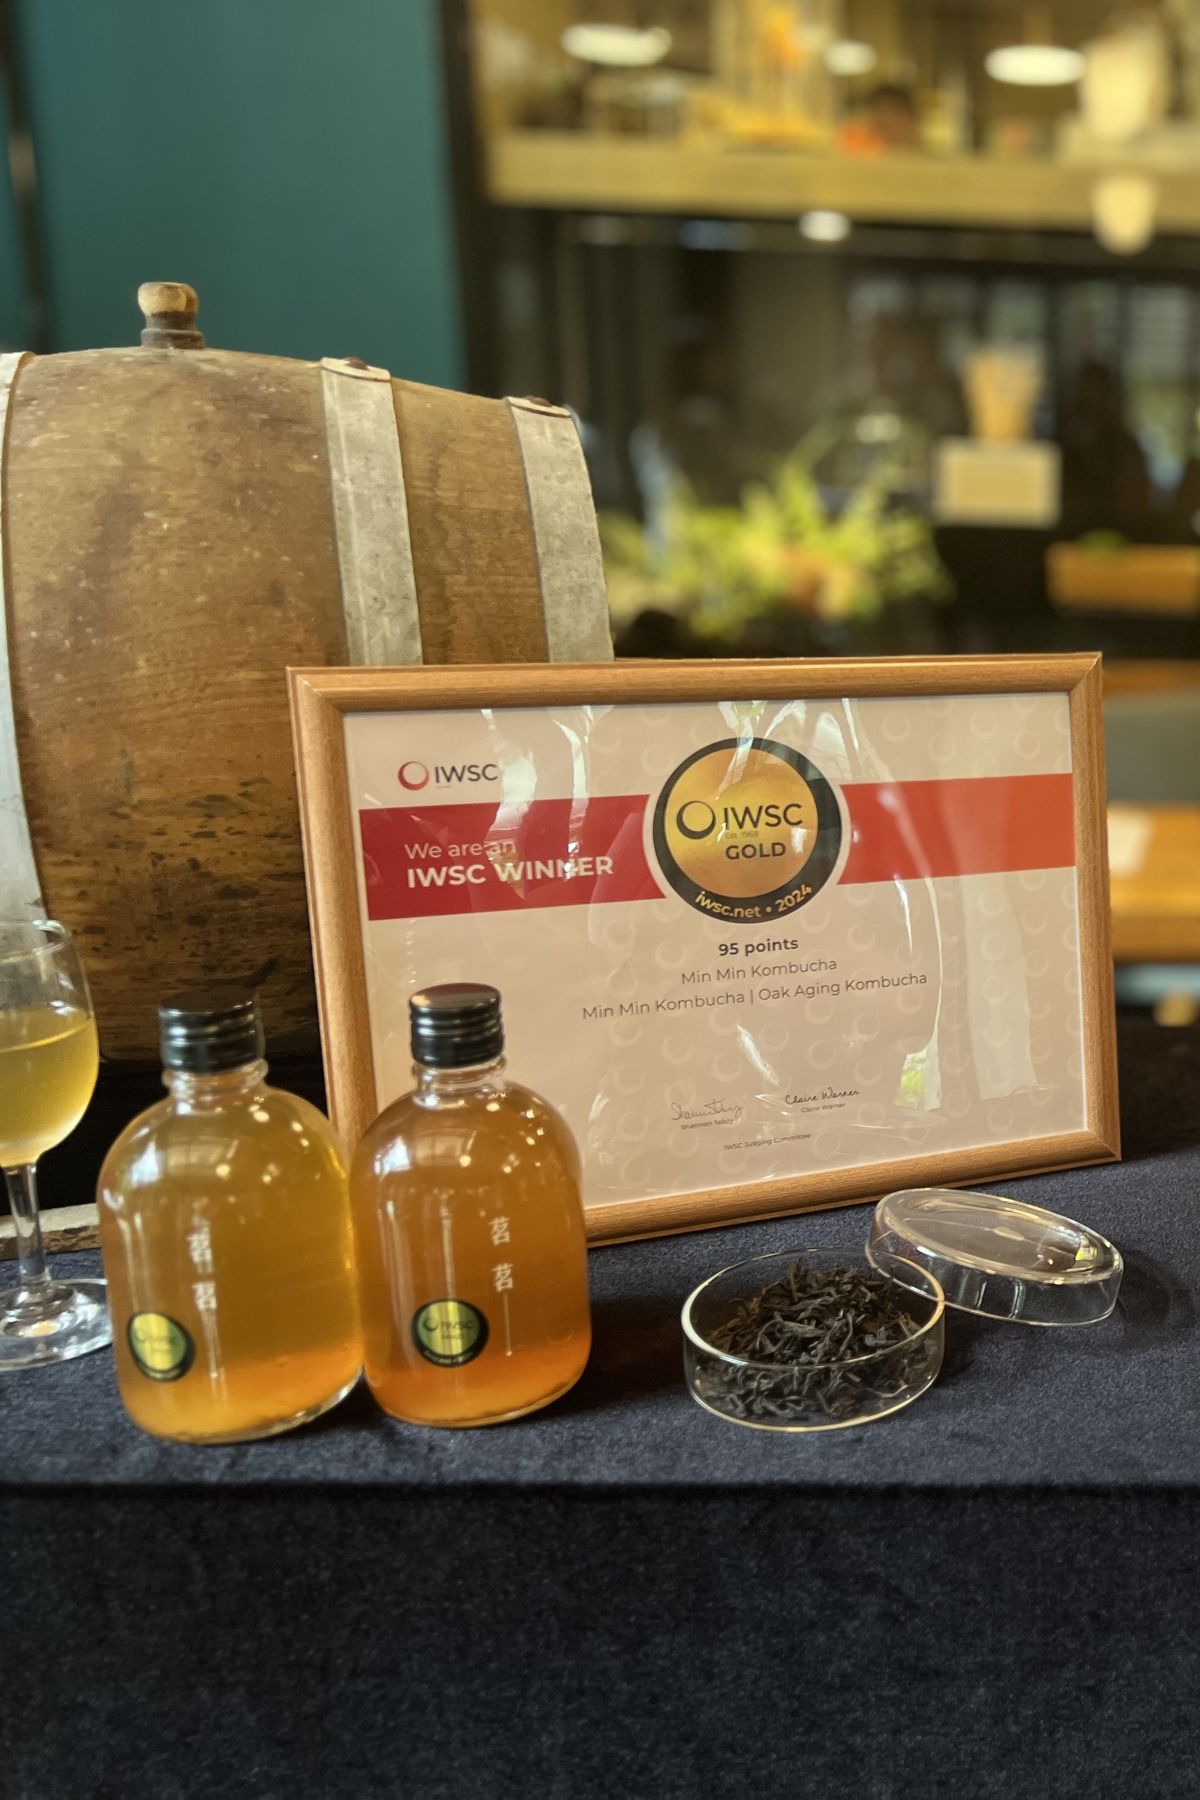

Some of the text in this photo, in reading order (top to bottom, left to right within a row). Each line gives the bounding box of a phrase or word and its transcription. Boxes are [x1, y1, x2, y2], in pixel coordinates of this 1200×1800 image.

[434, 764, 498, 784] IWSC
[724, 803, 803, 830] IWSC
[404, 840, 516, 860] We are an
[726, 842, 786, 860] GOLD
[407, 856, 614, 888] IWSC WINNER
[695, 884, 813, 918] iwsc.net 2024
[718, 938, 799, 957] 95 points
[681, 958, 837, 986] Min Min Kombucha
[582, 1006, 614, 1021] Min
[619, 1001, 650, 1017] Min
[656, 991, 745, 1013] Kombucha
[758, 987, 791, 1002] Oak
[794, 983, 840, 999] Aging
[845, 972, 927, 992] Kombucha
